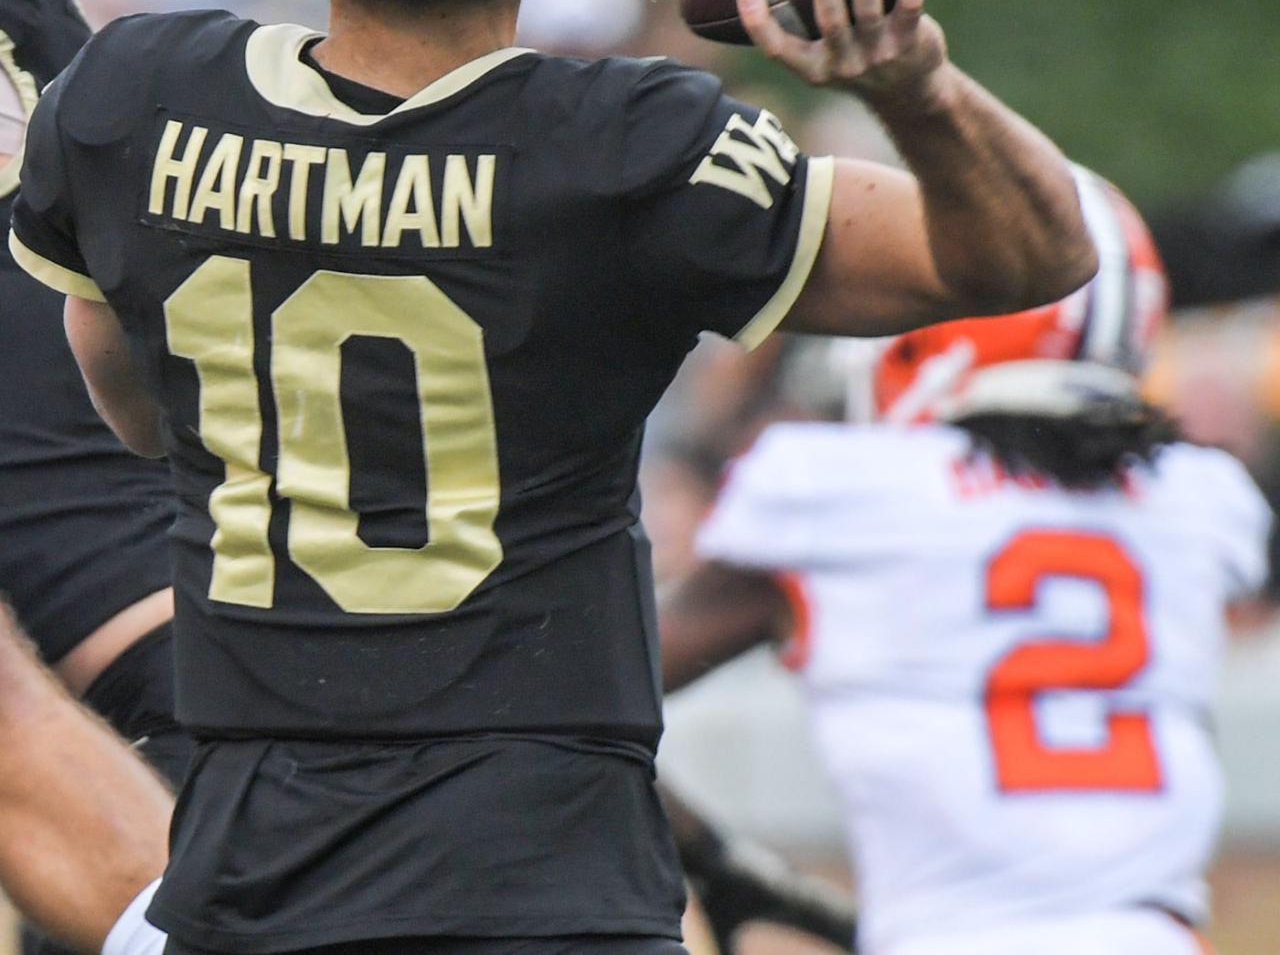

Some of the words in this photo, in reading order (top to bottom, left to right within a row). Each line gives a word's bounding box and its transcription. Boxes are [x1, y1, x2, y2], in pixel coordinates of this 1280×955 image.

[148, 119, 496, 248] HARTMAN
[162, 254, 504, 615] 10
[983, 528, 1165, 795] 2
